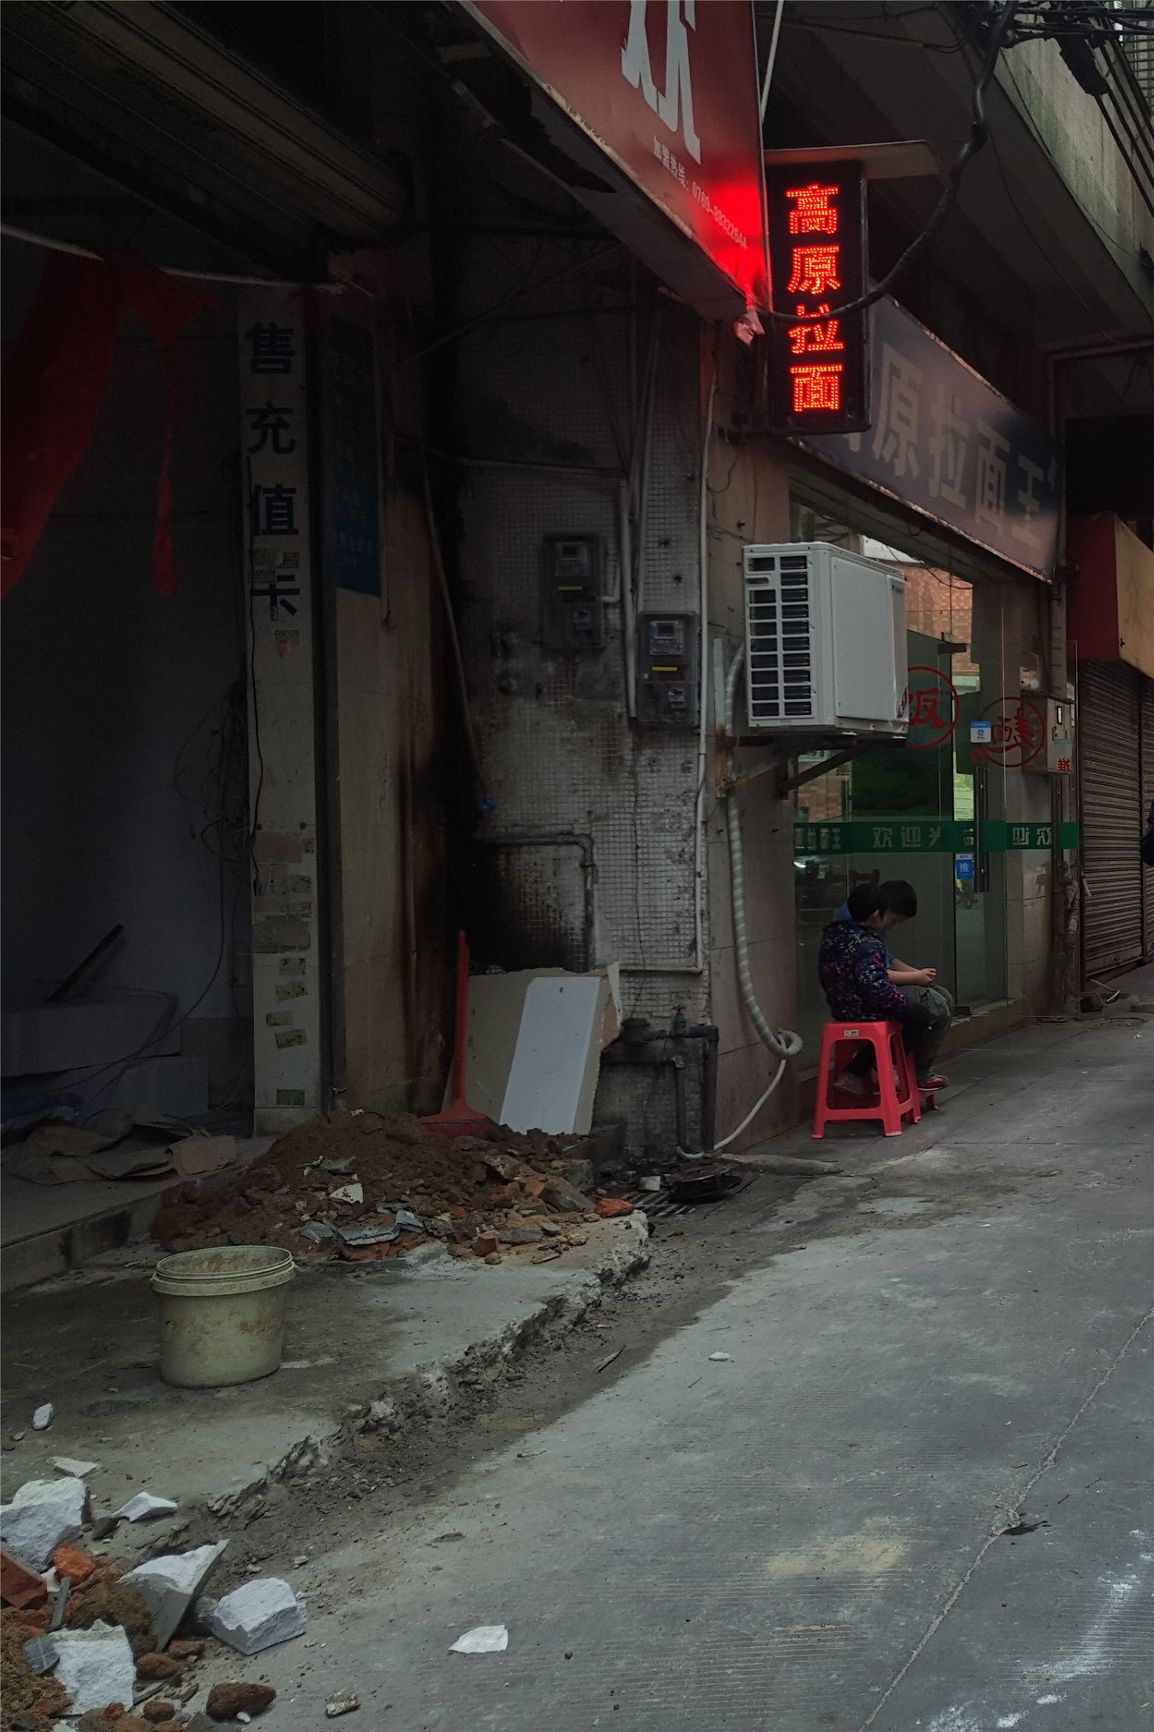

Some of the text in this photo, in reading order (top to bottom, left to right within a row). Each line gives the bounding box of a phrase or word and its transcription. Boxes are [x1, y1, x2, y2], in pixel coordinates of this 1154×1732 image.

[785, 184, 846, 413] 高原拉面
[246, 321, 300, 612] 售充值卡
[846, 343, 1045, 546] 原拉面王
